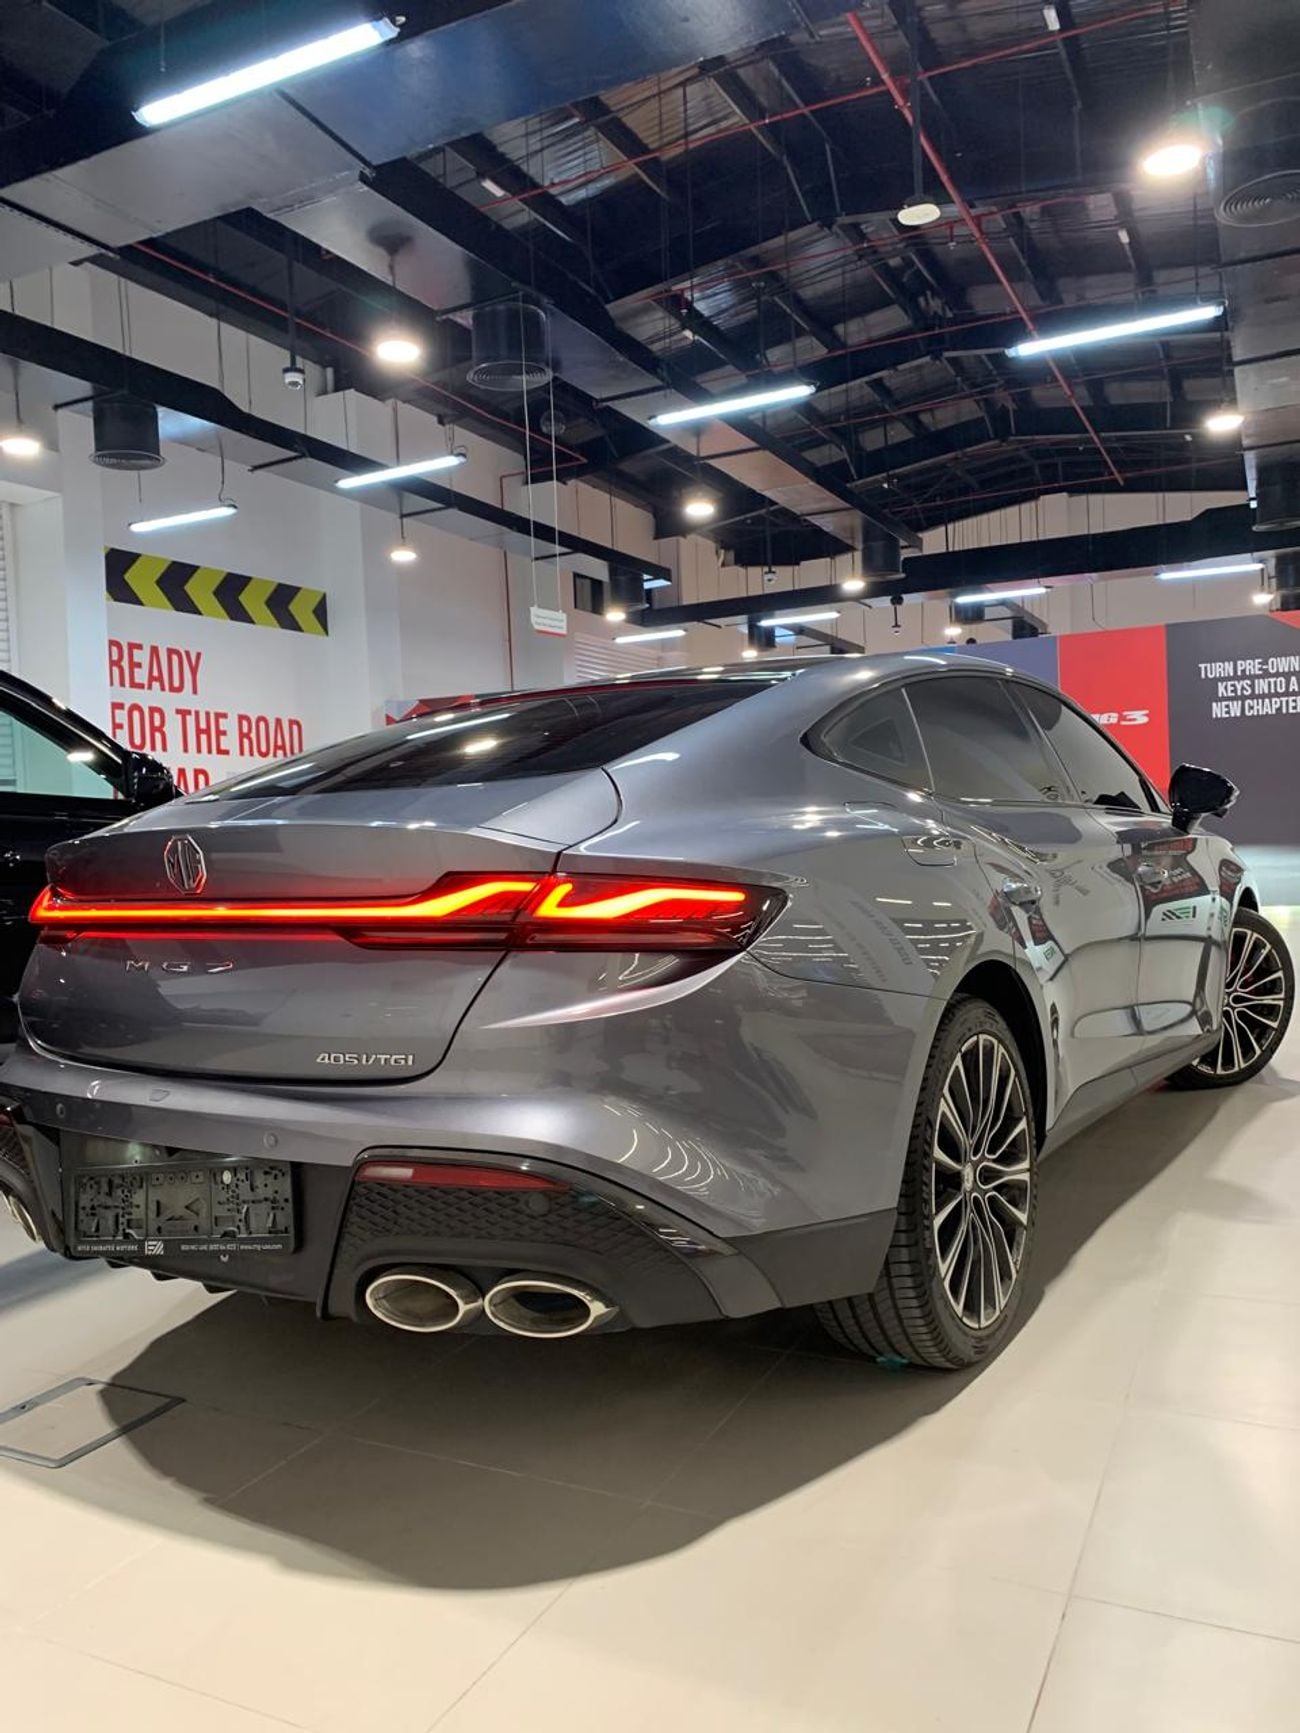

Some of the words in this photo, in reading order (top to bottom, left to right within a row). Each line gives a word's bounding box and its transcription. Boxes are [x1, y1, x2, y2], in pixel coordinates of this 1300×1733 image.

[108, 639, 202, 695] READY
[1198, 661, 1233, 679] TURN
[1218, 680, 1252, 697] KEYS
[1255, 677, 1286, 695] INTO
[1289, 676, 1299, 692] A
[1212, 700, 1241, 719] NEW
[111, 702, 167, 753] FOR
[175, 708, 230, 755] THE
[237, 713, 304, 758] ROAD
